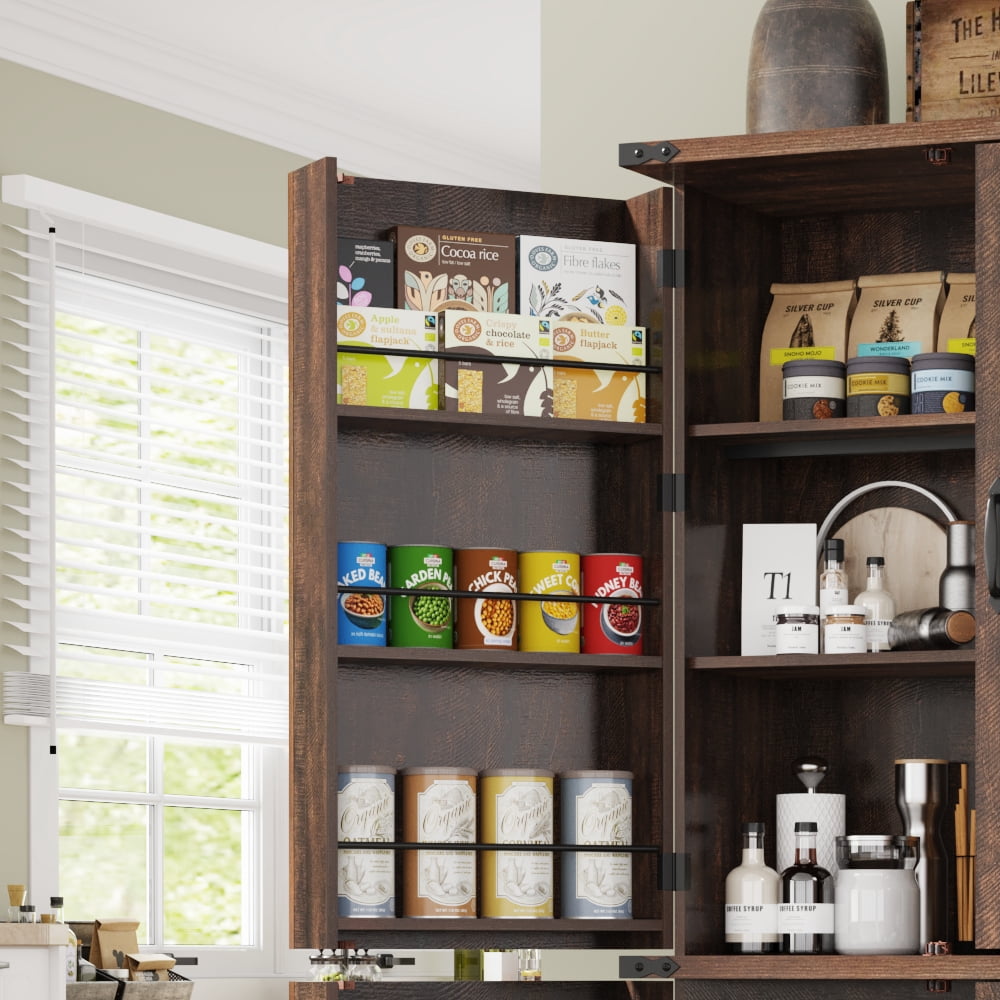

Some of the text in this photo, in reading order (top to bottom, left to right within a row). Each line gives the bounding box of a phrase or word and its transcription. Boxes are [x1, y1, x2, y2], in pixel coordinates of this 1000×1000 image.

[951, 16, 983, 43] THE
[442, 234, 466, 242] GLUTEN
[441, 245, 499, 261] Cocoa rice
[563, 255, 621, 270] Fibre flakes
[785, 304, 815, 313] SILVER
[816, 303, 835, 311] CUP
[873, 298, 922, 308] SILVER CUP
[370, 314, 400, 324] Apple
[486, 319, 518, 329] Crispy
[486, 329, 531, 339] chocolate
[580, 329, 611, 339] Butter
[370, 335, 409, 345] flapjack
[496, 340, 515, 348] rice
[580, 339, 617, 350] flapjack
[468, 571, 502, 591] CHICK
[530, 574, 563, 595] WEET
[763, 572, 792, 600] T1
